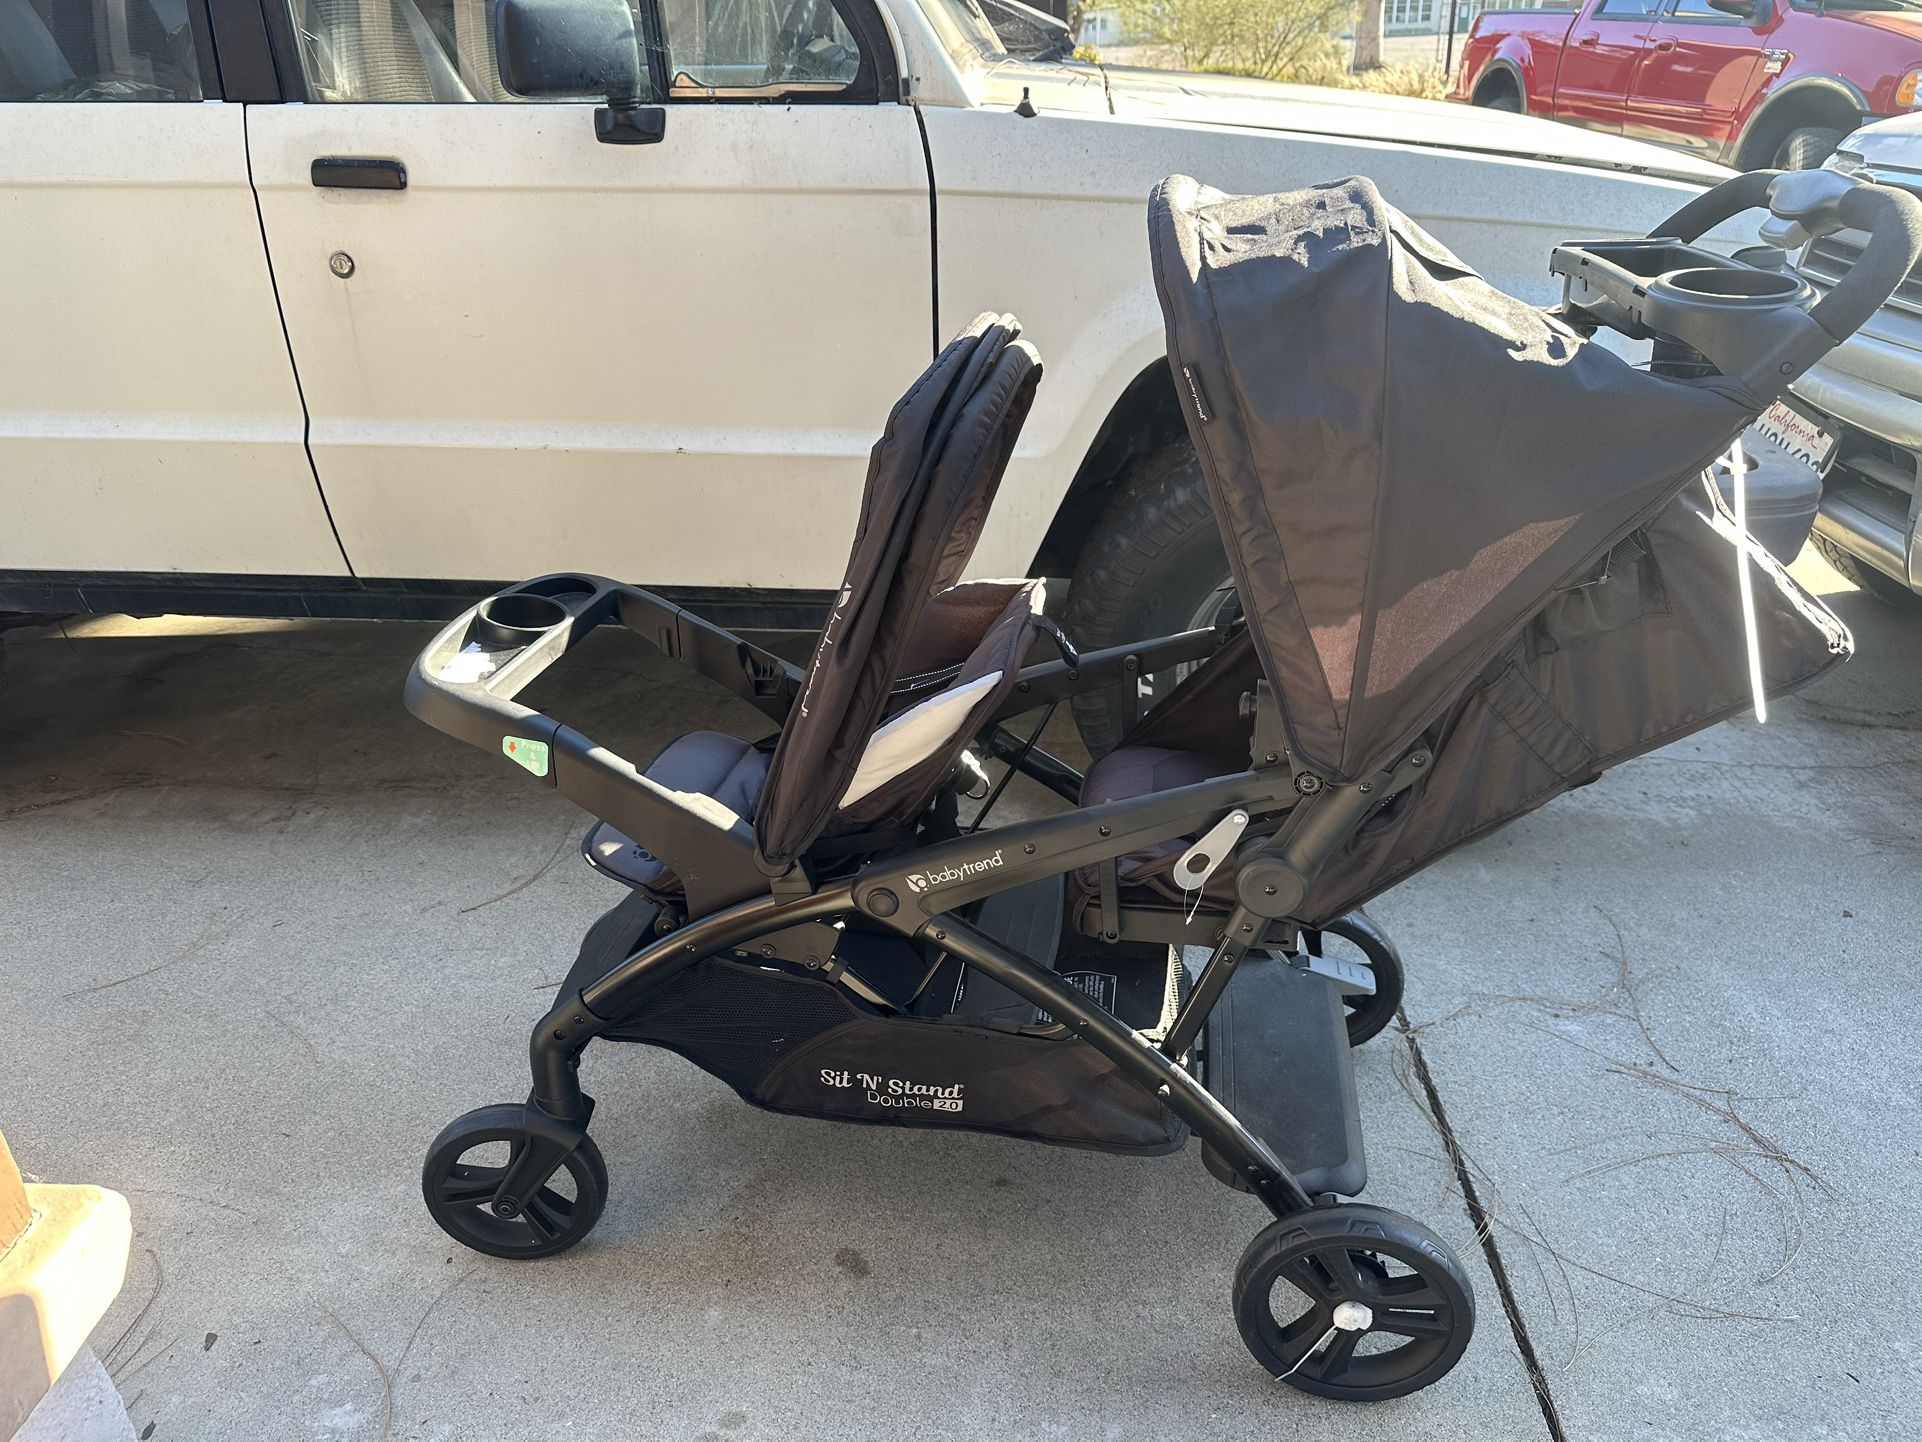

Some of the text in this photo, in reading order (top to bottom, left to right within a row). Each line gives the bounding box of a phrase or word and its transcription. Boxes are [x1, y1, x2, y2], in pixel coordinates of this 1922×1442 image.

[1768, 402, 1818, 449] California
[520, 740, 546, 753] Press
[926, 850, 1004, 885] babytrend
[820, 1068, 963, 1099] Sit N' Stand
[867, 1090, 959, 1111] Double 2.0
